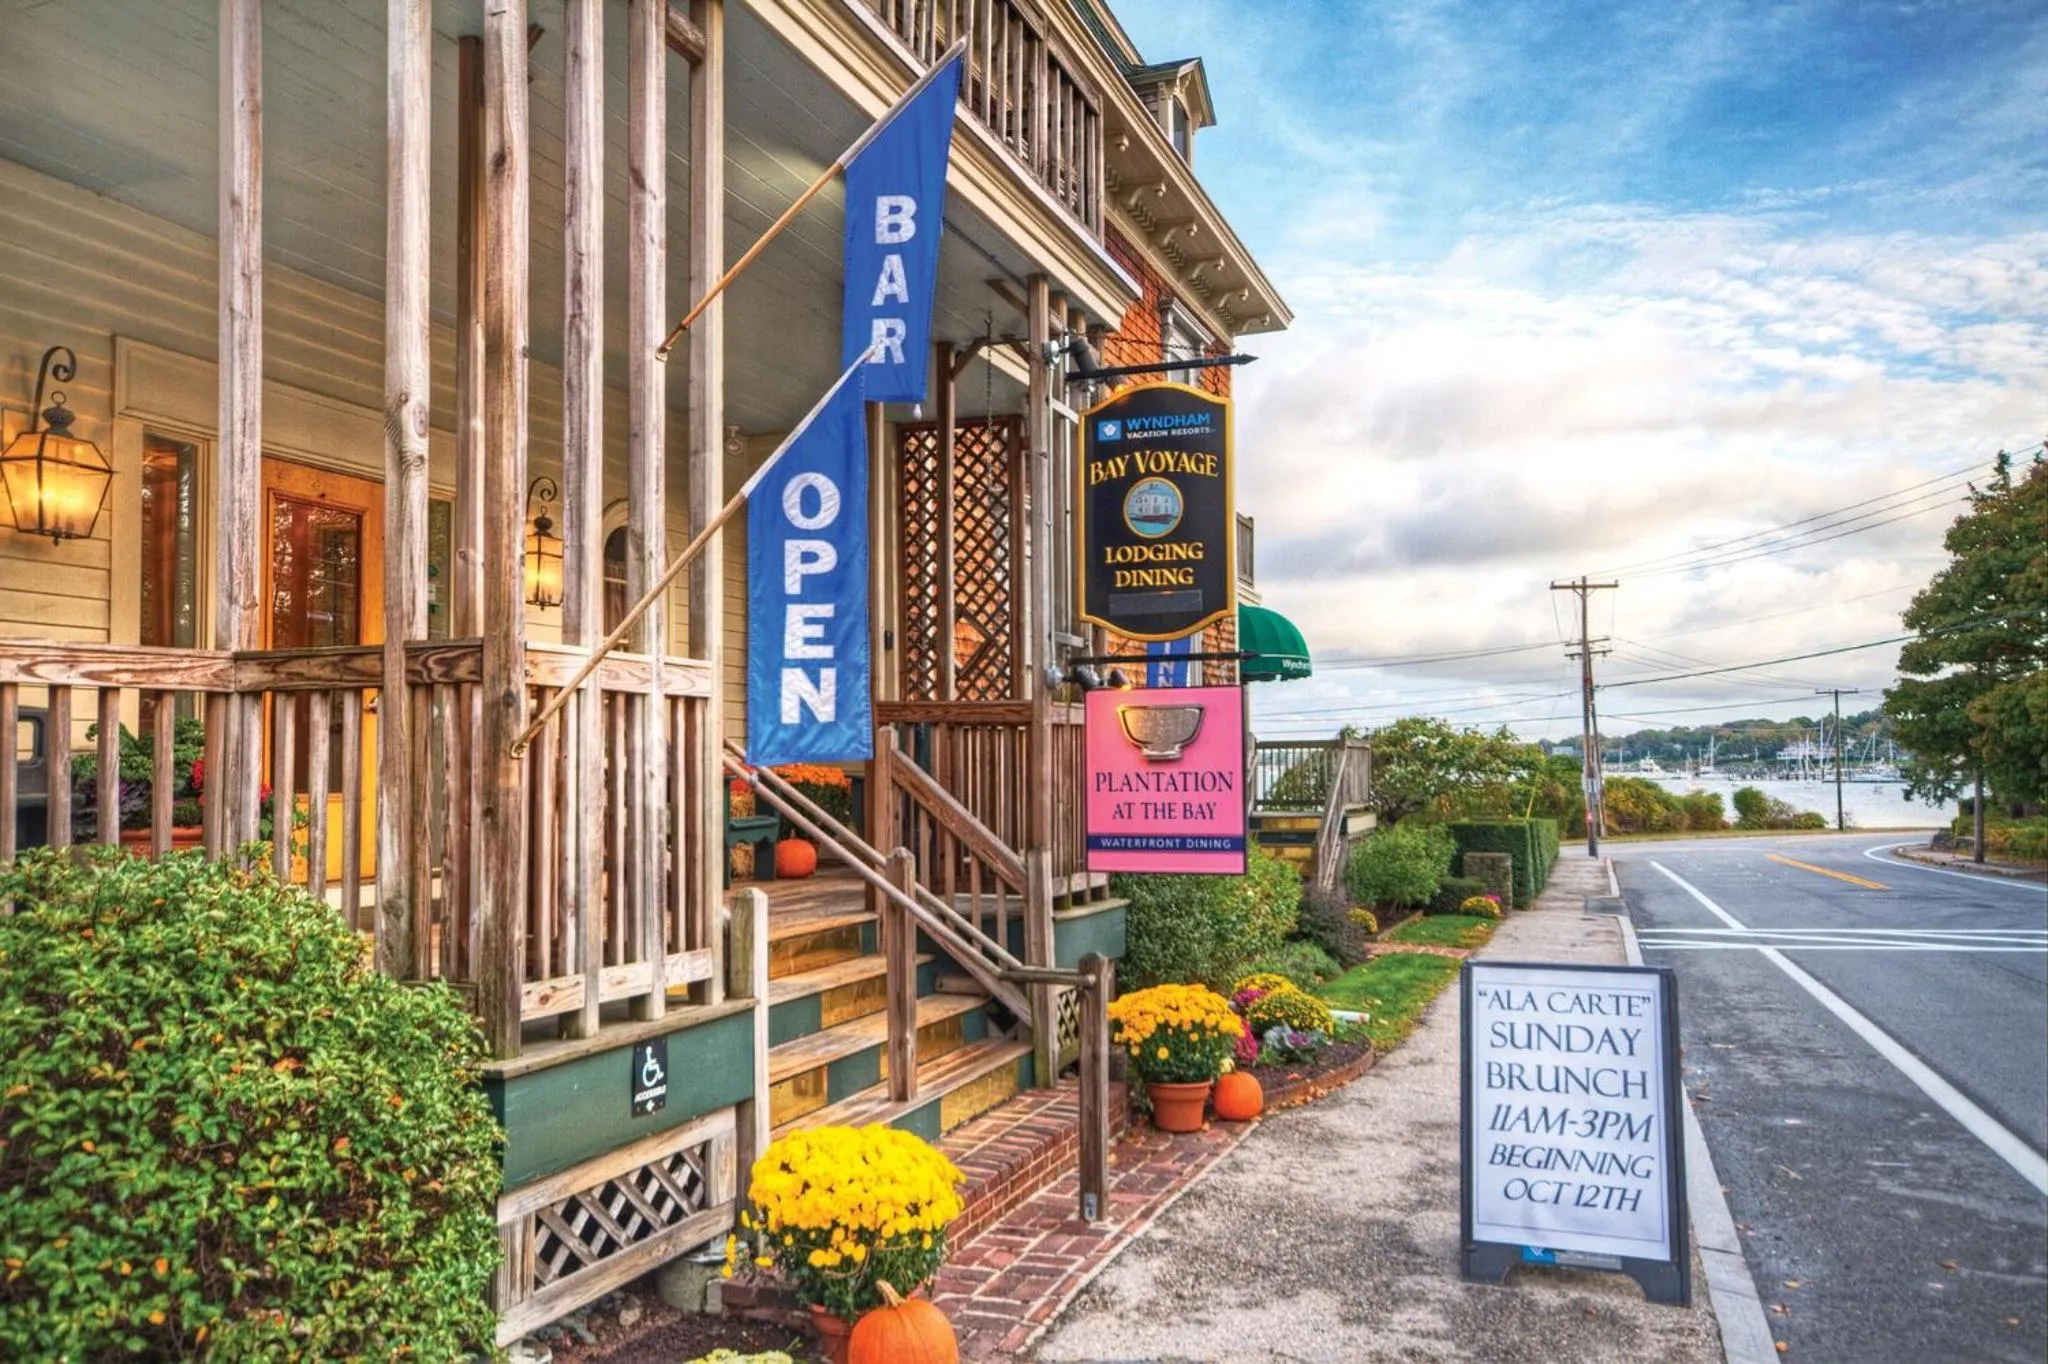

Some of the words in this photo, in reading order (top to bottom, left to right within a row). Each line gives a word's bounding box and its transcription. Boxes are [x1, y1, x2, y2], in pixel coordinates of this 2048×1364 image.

[871, 195, 917, 364] BAR
[1126, 412, 1211, 430] WYNDHAM
[1126, 430, 1168, 439] VACATION
[1171, 426, 1211, 436] RESORTS
[1090, 453, 1130, 485] BAY
[1133, 449, 1219, 478] VOYAGE
[1104, 542, 1204, 564] LODGING
[1114, 567, 1194, 588] DINING
[780, 471, 841, 724] OPEN
[1095, 770, 1234, 793] PLANTATION
[1112, 802, 1137, 820] AT
[1140, 802, 1177, 820] THE
[1181, 802, 1217, 820] BAY
[1100, 837, 1182, 849] WATERFRONT
[1185, 838, 1232, 849] DINING
[1489, 1020, 1642, 1057] SUNDAY
[1486, 1060, 1649, 1100] BRUNCH
[1488, 1103, 1655, 1143] 11AM-3PM
[1488, 1142, 1656, 1180] BEGINNING
[1503, 1177, 1572, 1206] OCT
[1573, 1184, 1643, 1213] 12TH
